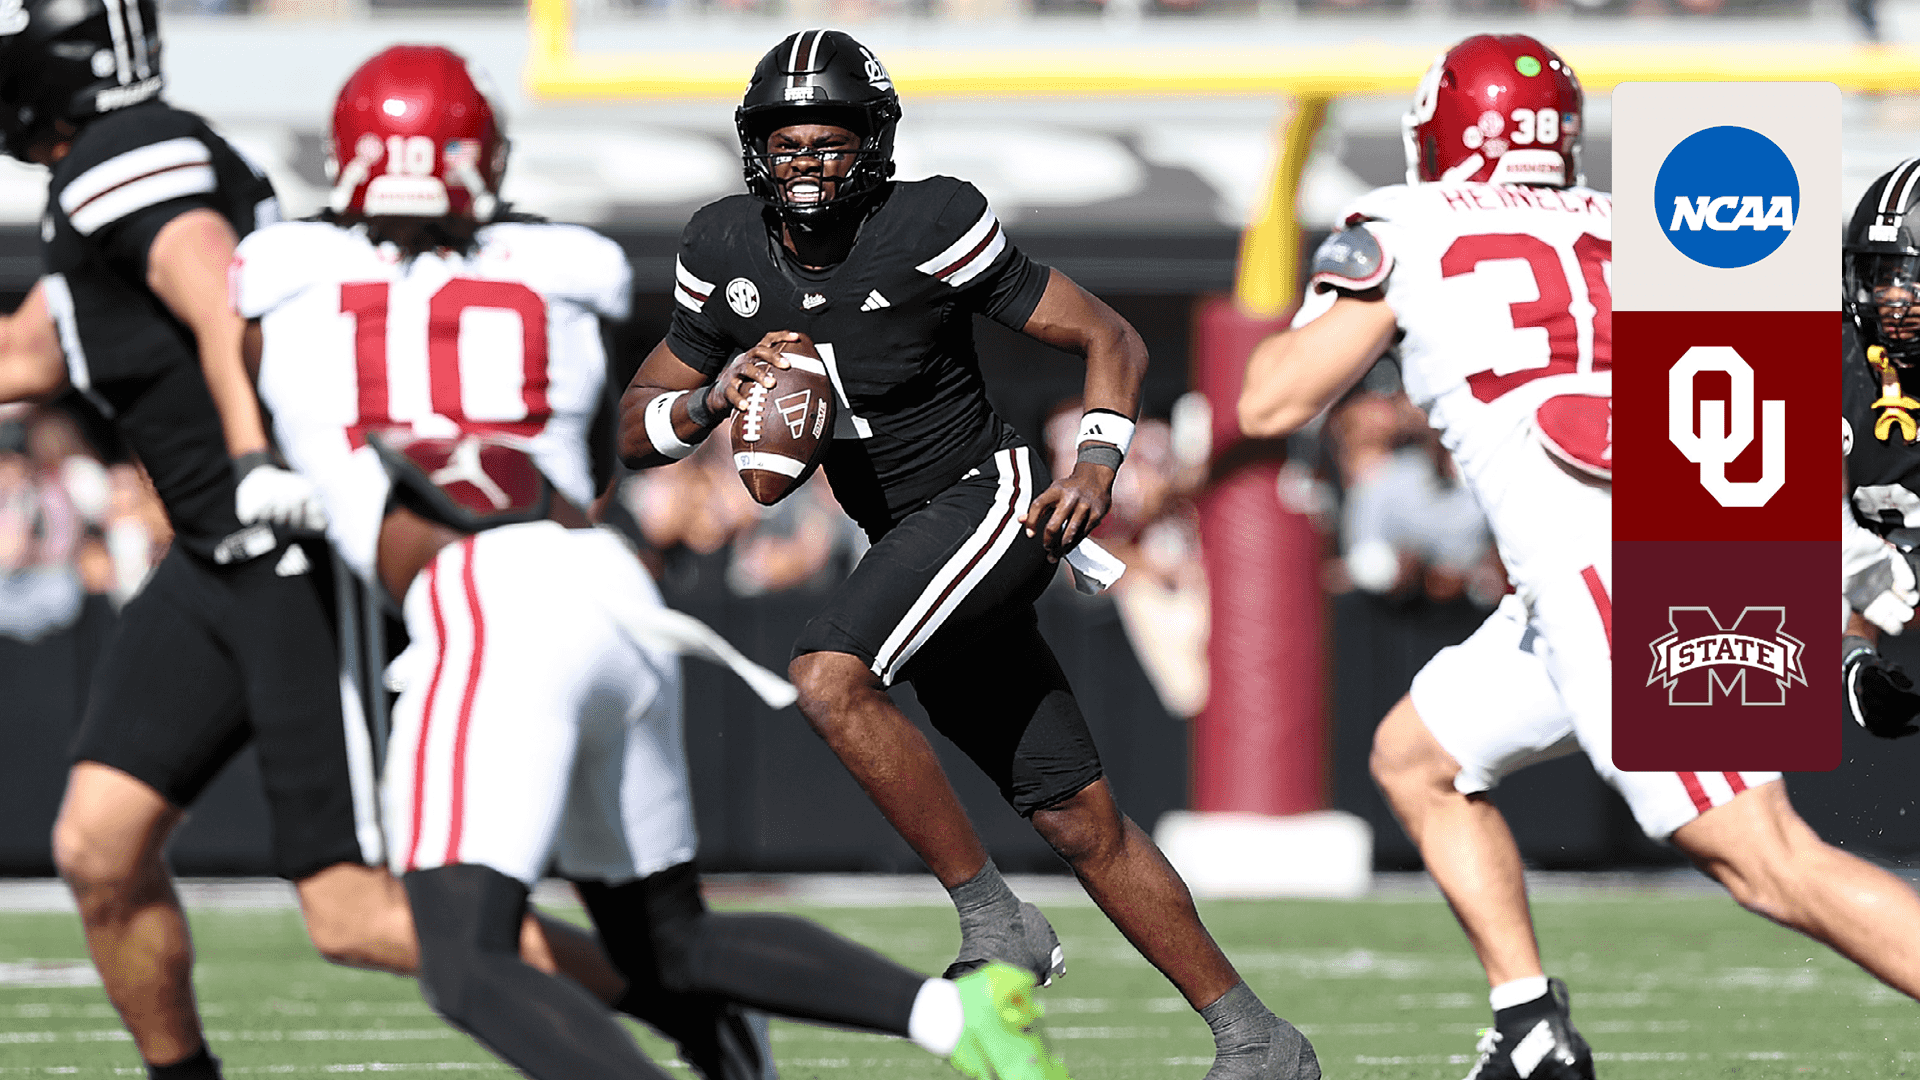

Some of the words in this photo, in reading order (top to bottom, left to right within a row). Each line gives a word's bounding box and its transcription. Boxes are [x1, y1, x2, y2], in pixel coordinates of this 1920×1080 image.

[1510, 107, 1559, 145] 38
[386, 135, 435, 175] 10
[1440, 185, 1612, 217] HEINECK
[340, 277, 552, 452] 10
